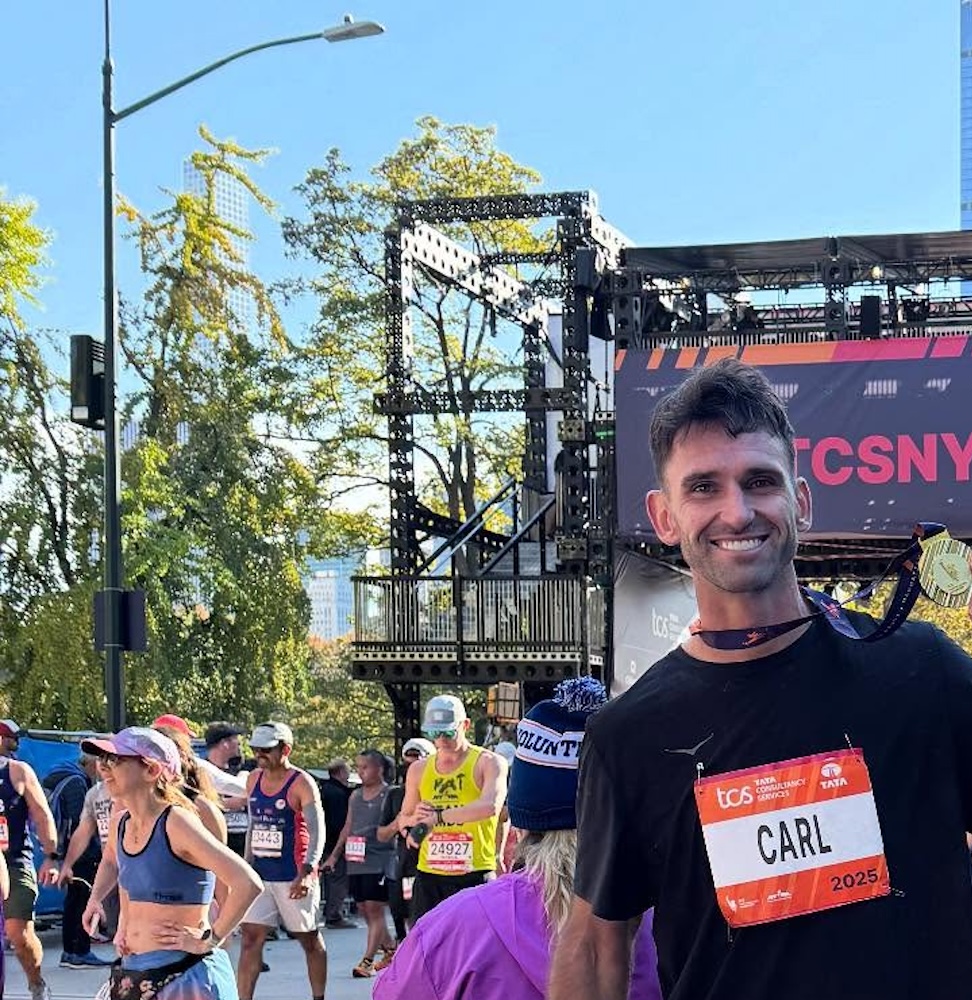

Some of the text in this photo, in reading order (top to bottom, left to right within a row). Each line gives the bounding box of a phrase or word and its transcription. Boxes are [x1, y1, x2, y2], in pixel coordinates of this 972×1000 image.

[519, 729, 580, 757] OLUNT
[754, 776, 777, 786] TATA
[820, 778, 848, 790] TATA
[716, 786, 753, 809] tcs
[430, 842, 470, 856] 24927
[757, 815, 832, 865] CARL
[830, 868, 879, 891] 2025
